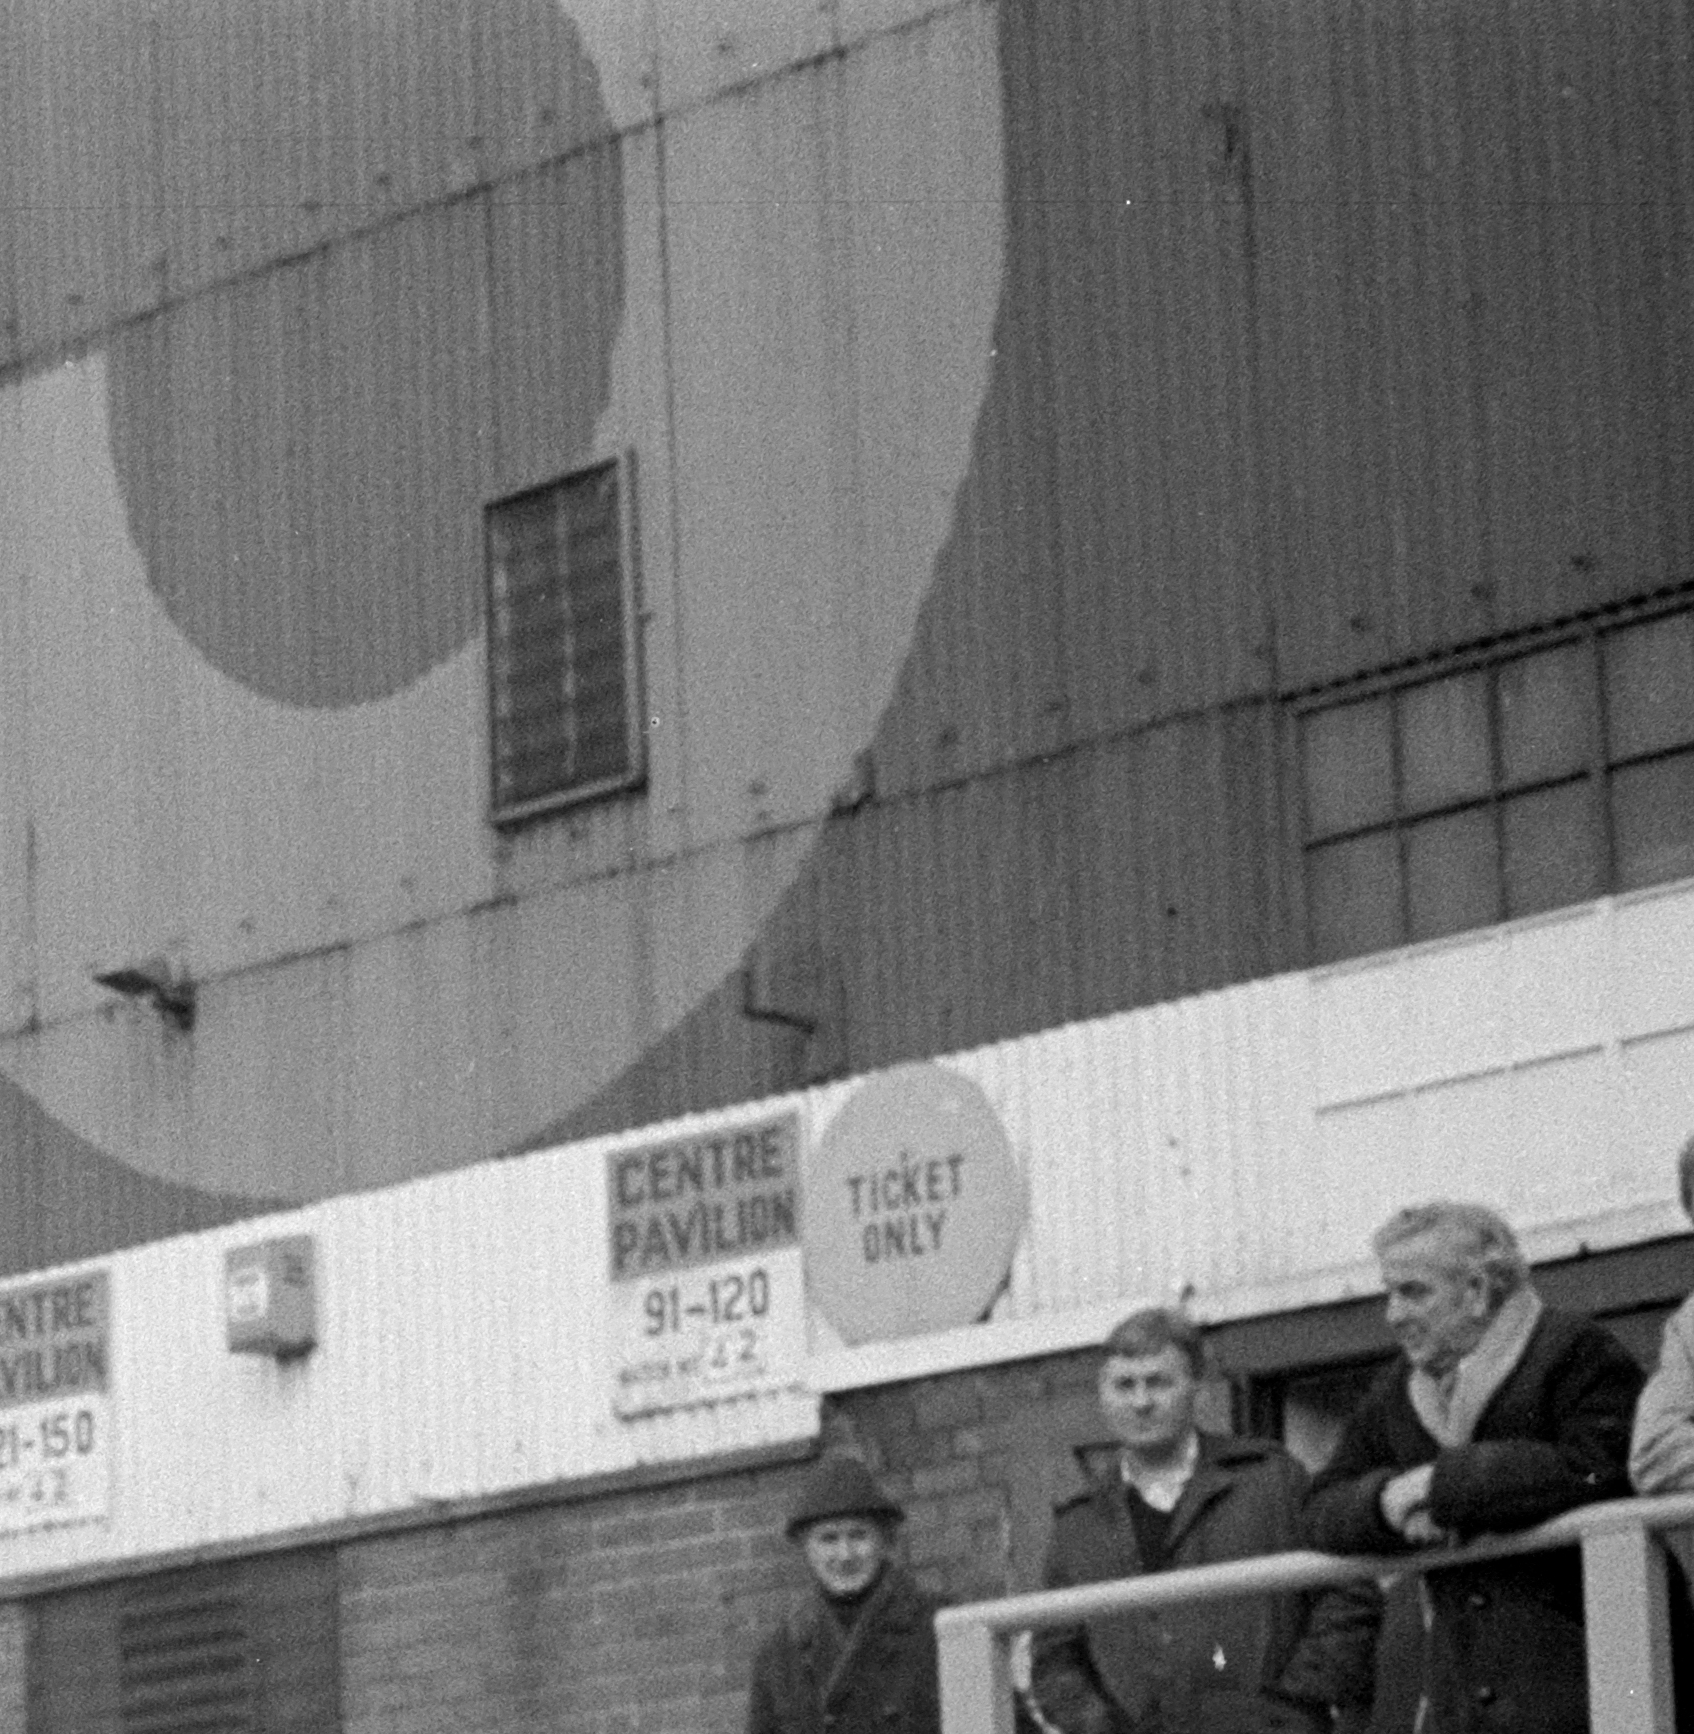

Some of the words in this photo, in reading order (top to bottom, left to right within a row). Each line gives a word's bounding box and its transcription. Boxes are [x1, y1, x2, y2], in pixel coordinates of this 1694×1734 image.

[616, 1124, 784, 1206] CENTRE
[846, 1151, 964, 1215] TICKET
[614, 1187, 797, 1271] PAVILION
[862, 1209, 948, 1264] ONLY
[643, 1266, 770, 1338] 91-120
